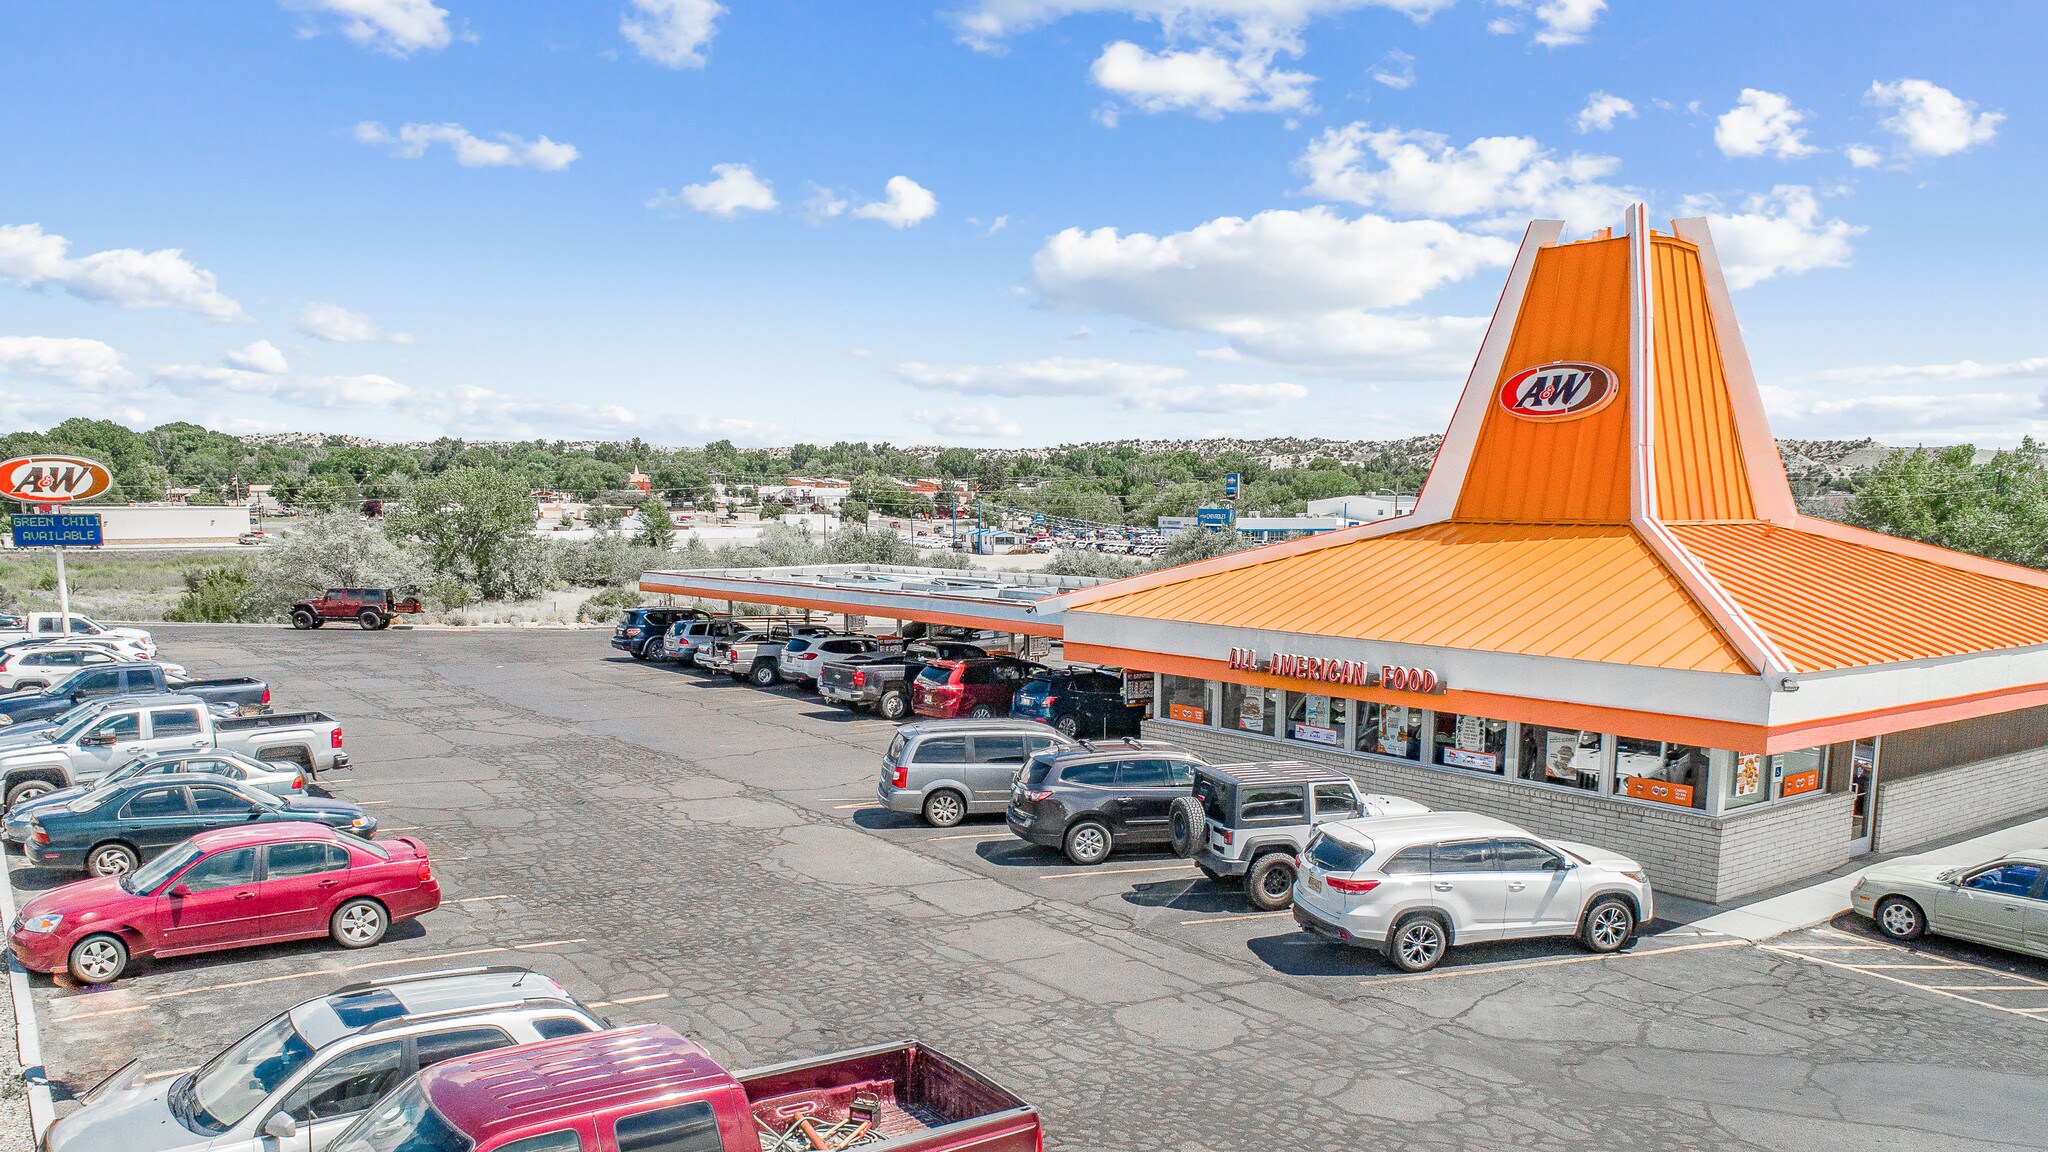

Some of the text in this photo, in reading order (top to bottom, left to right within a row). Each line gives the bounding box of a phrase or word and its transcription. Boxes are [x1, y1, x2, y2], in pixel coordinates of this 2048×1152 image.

[1513, 371, 1593, 409] A&W
[11, 466, 91, 493] A&W
[13, 516, 100, 527] GREEN CHILI
[22, 531, 95, 540] AVAILABLE
[1229, 647, 1439, 693] ALL AMERICAN FOOD
